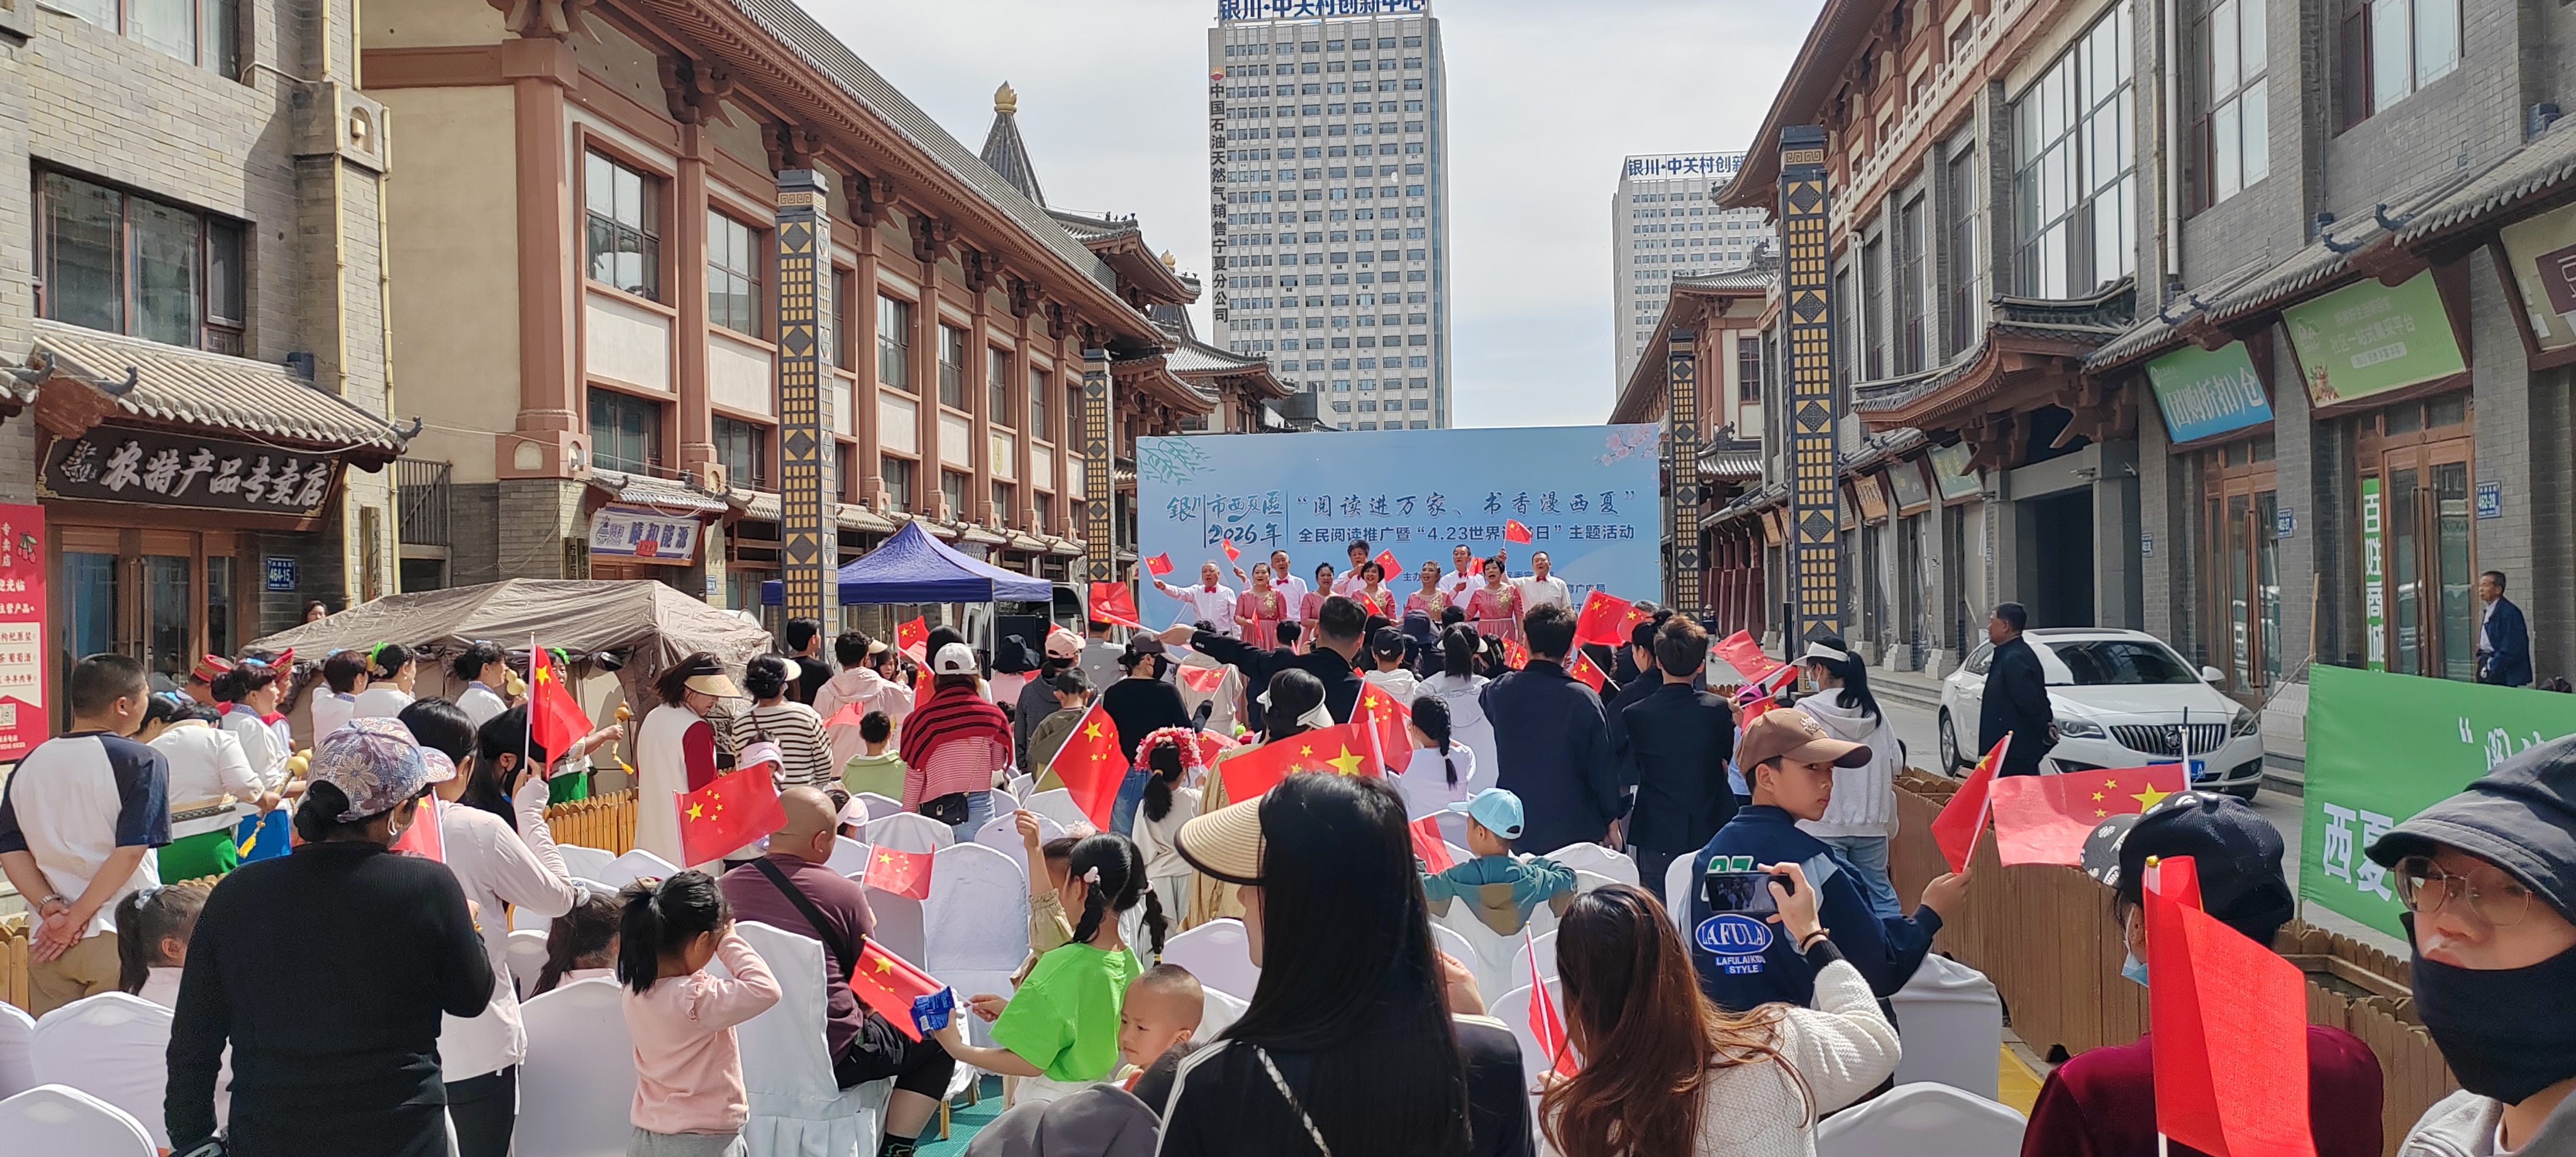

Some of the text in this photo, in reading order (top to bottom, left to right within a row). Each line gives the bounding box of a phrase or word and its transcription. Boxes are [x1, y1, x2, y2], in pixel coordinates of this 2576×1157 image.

[1210, 82, 1229, 324] 中国石油天然气销售宁夏分公司
[99, 440, 328, 506] 农特产品专卖店
[1298, 524, 1635, 543] 全民阅读推广暨“4.23世界日”主题活动
[269, 568, 291, 582] 464-15
[2364, 493, 2385, 672] 百姓商城
[1701, 923, 1766, 946] LAFULAI
[1729, 965, 1759, 974] STYLE
